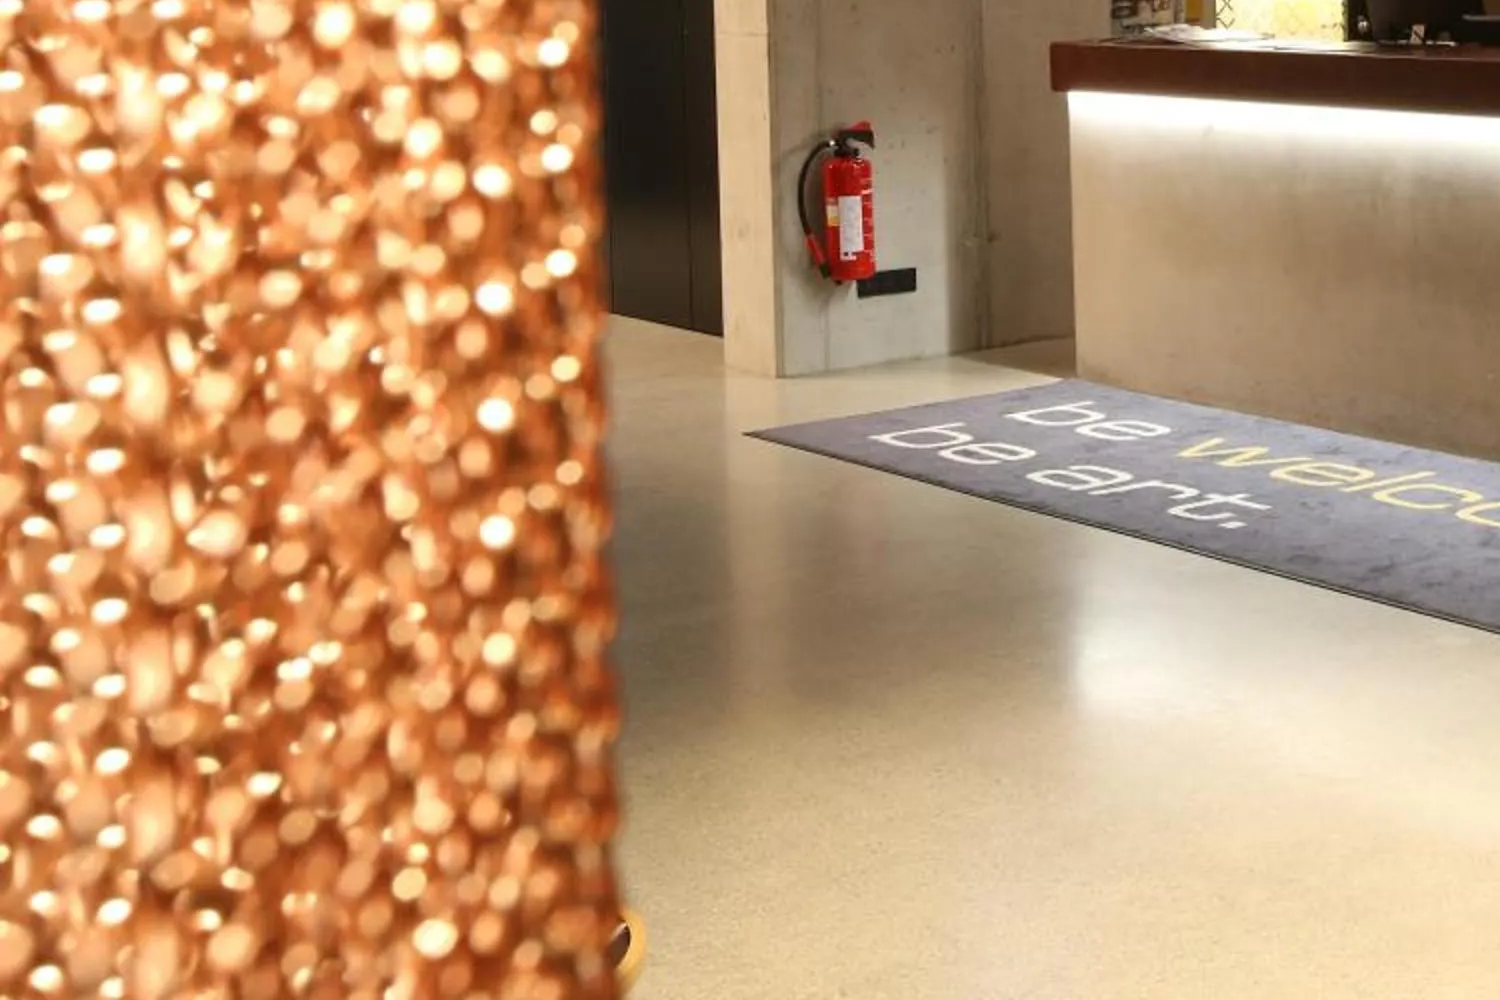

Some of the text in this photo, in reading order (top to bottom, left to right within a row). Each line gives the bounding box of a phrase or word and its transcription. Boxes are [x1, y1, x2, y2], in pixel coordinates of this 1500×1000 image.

[1004, 400, 1172, 442] be
[867, 421, 1273, 531] be art.
